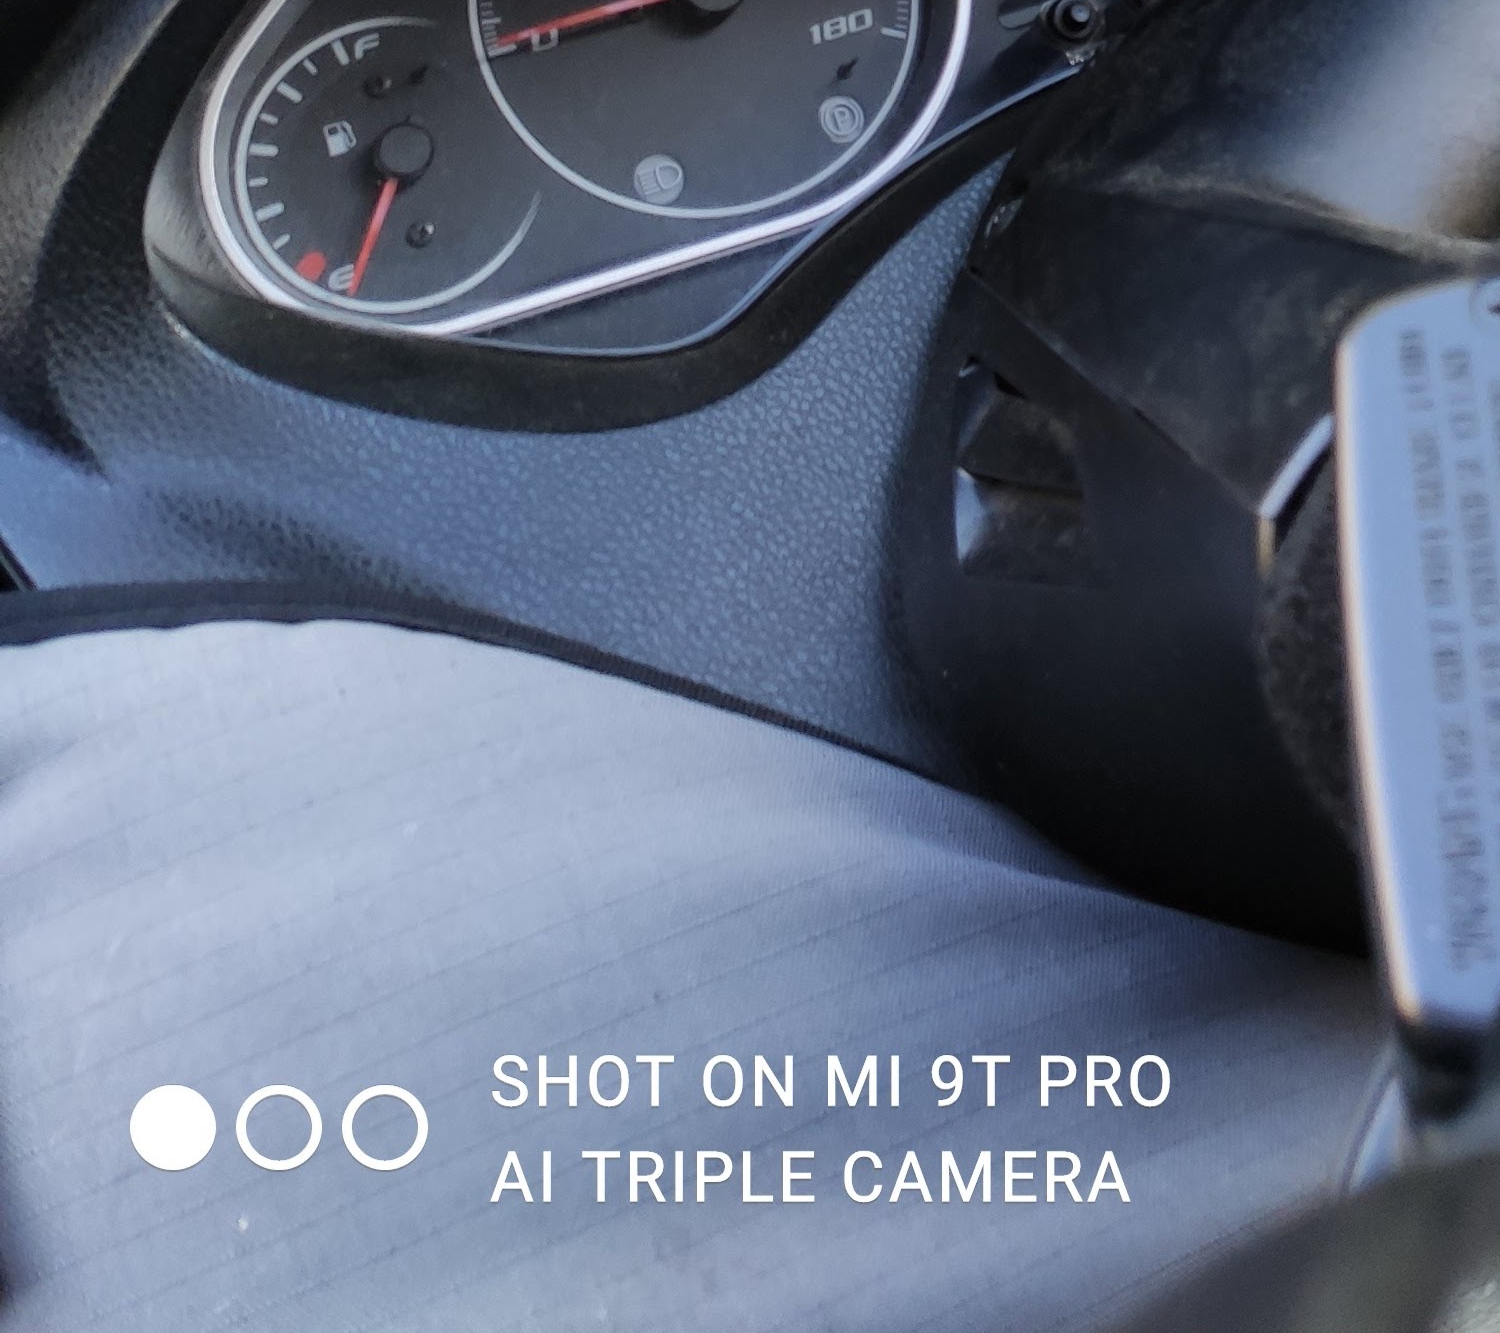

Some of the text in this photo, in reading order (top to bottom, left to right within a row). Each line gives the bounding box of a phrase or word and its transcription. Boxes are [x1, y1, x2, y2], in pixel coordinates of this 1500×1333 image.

[529, 27, 562, 55] 0
[808, 7, 876, 46] 180
[352, 32, 381, 61] F
